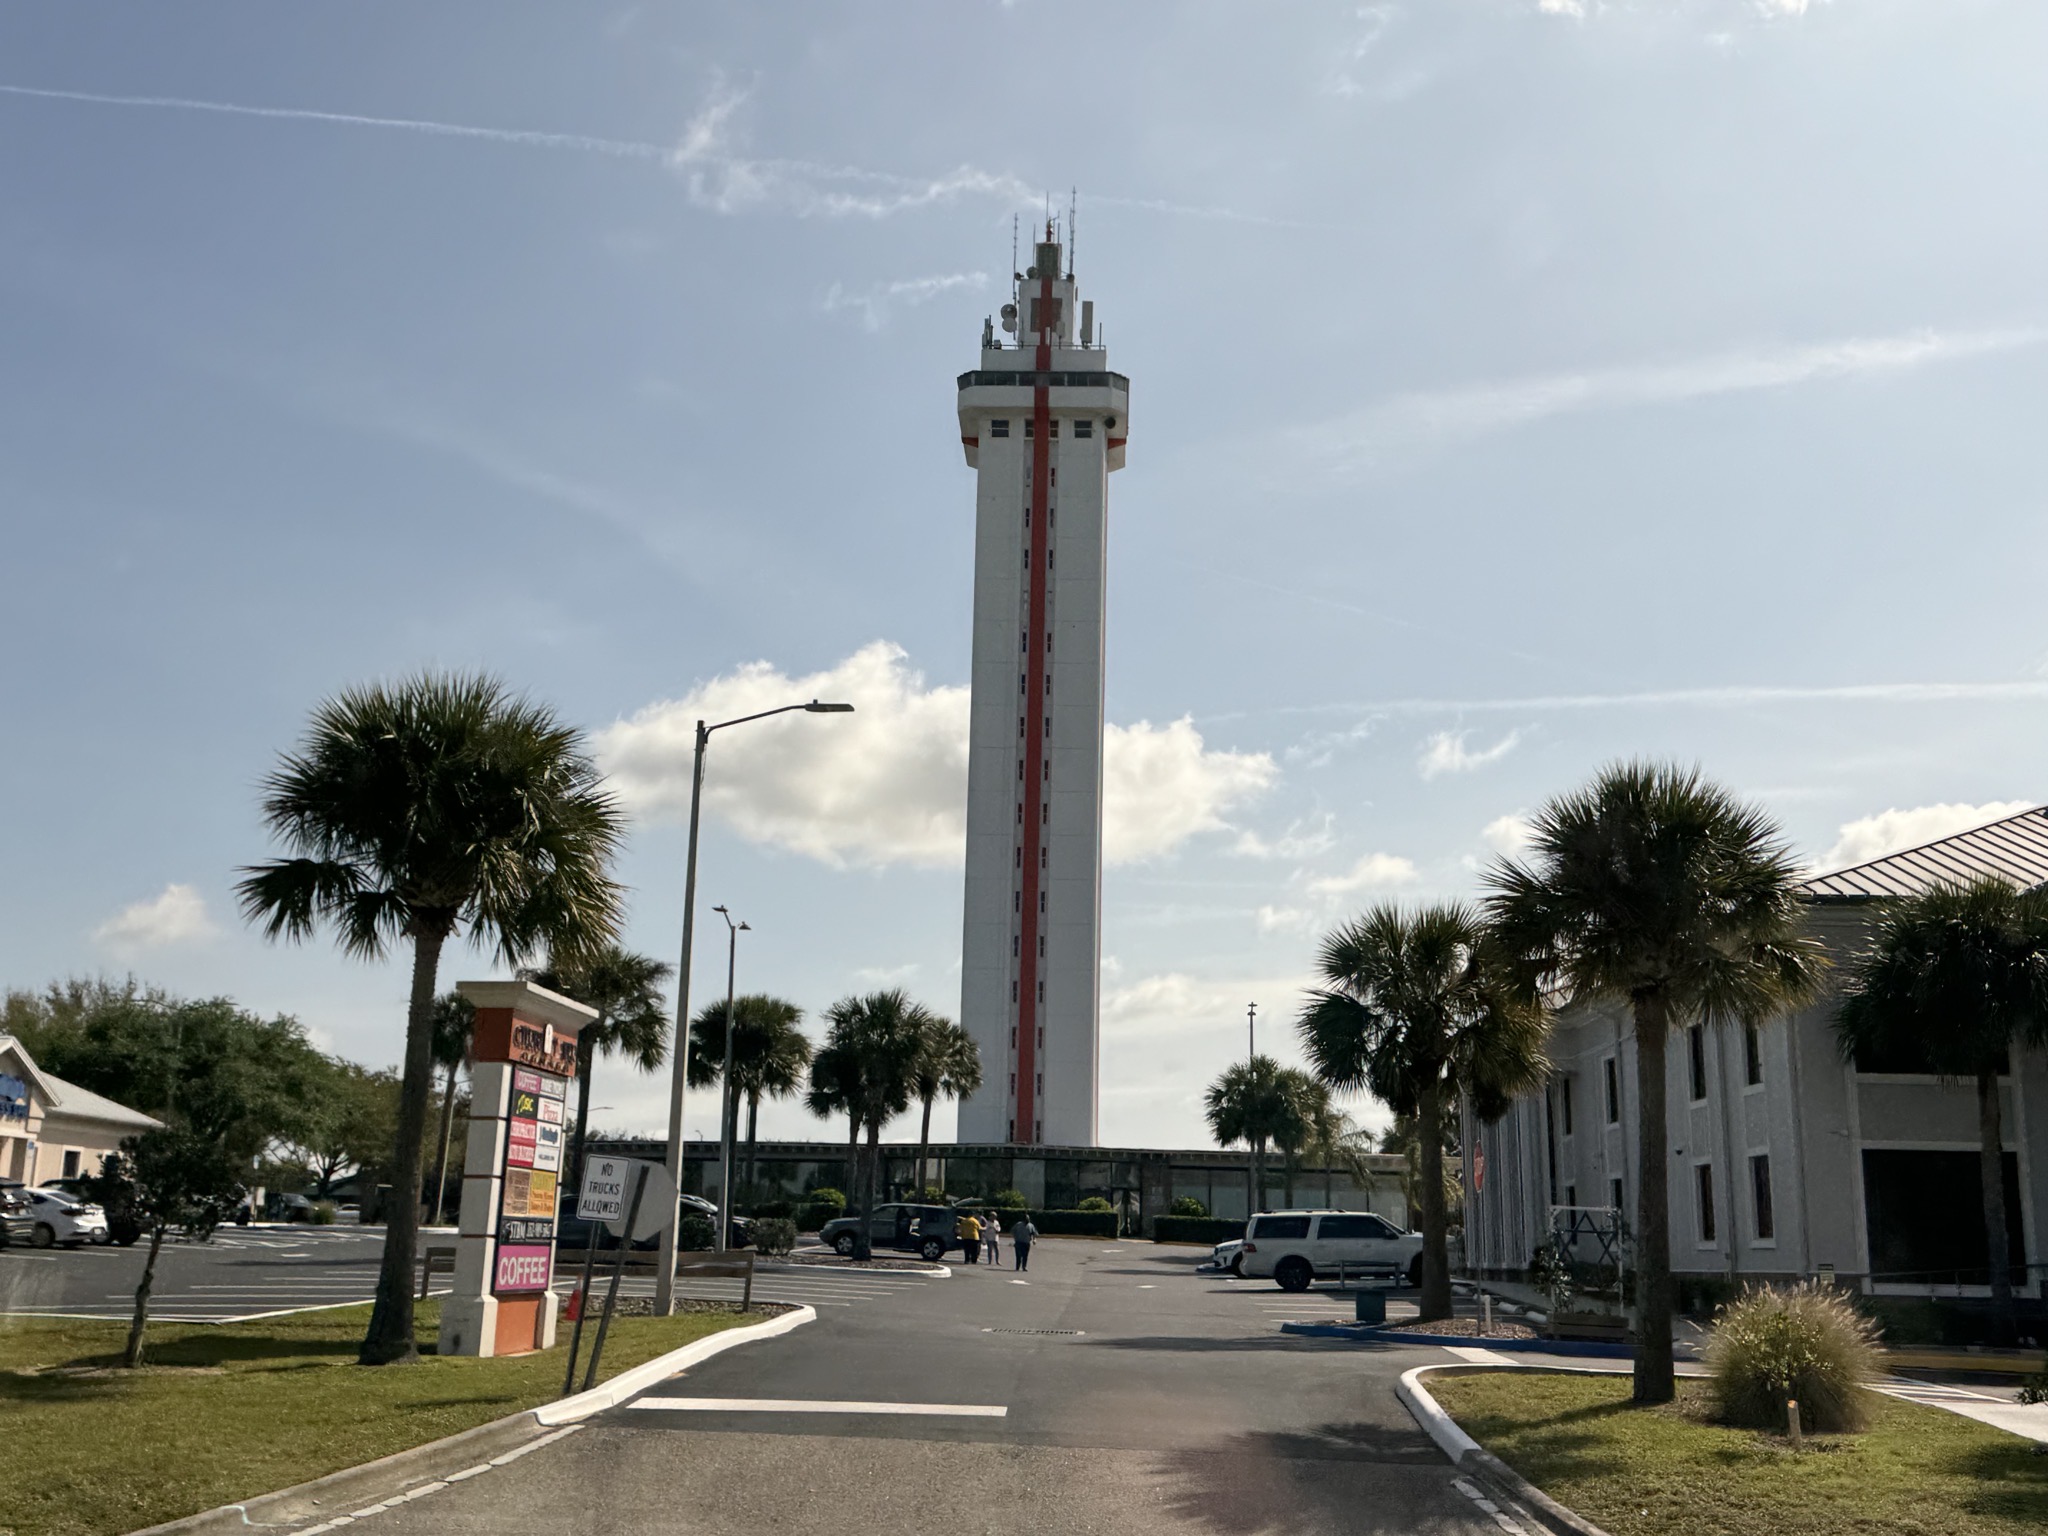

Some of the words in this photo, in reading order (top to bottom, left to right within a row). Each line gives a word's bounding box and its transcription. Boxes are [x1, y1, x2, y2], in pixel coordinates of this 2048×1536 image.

[601, 1163, 613, 1177] NO
[589, 1181, 620, 1196] TRUCKS
[582, 1200, 619, 1214] ALLOWED
[499, 1257, 547, 1286] COFFEE
